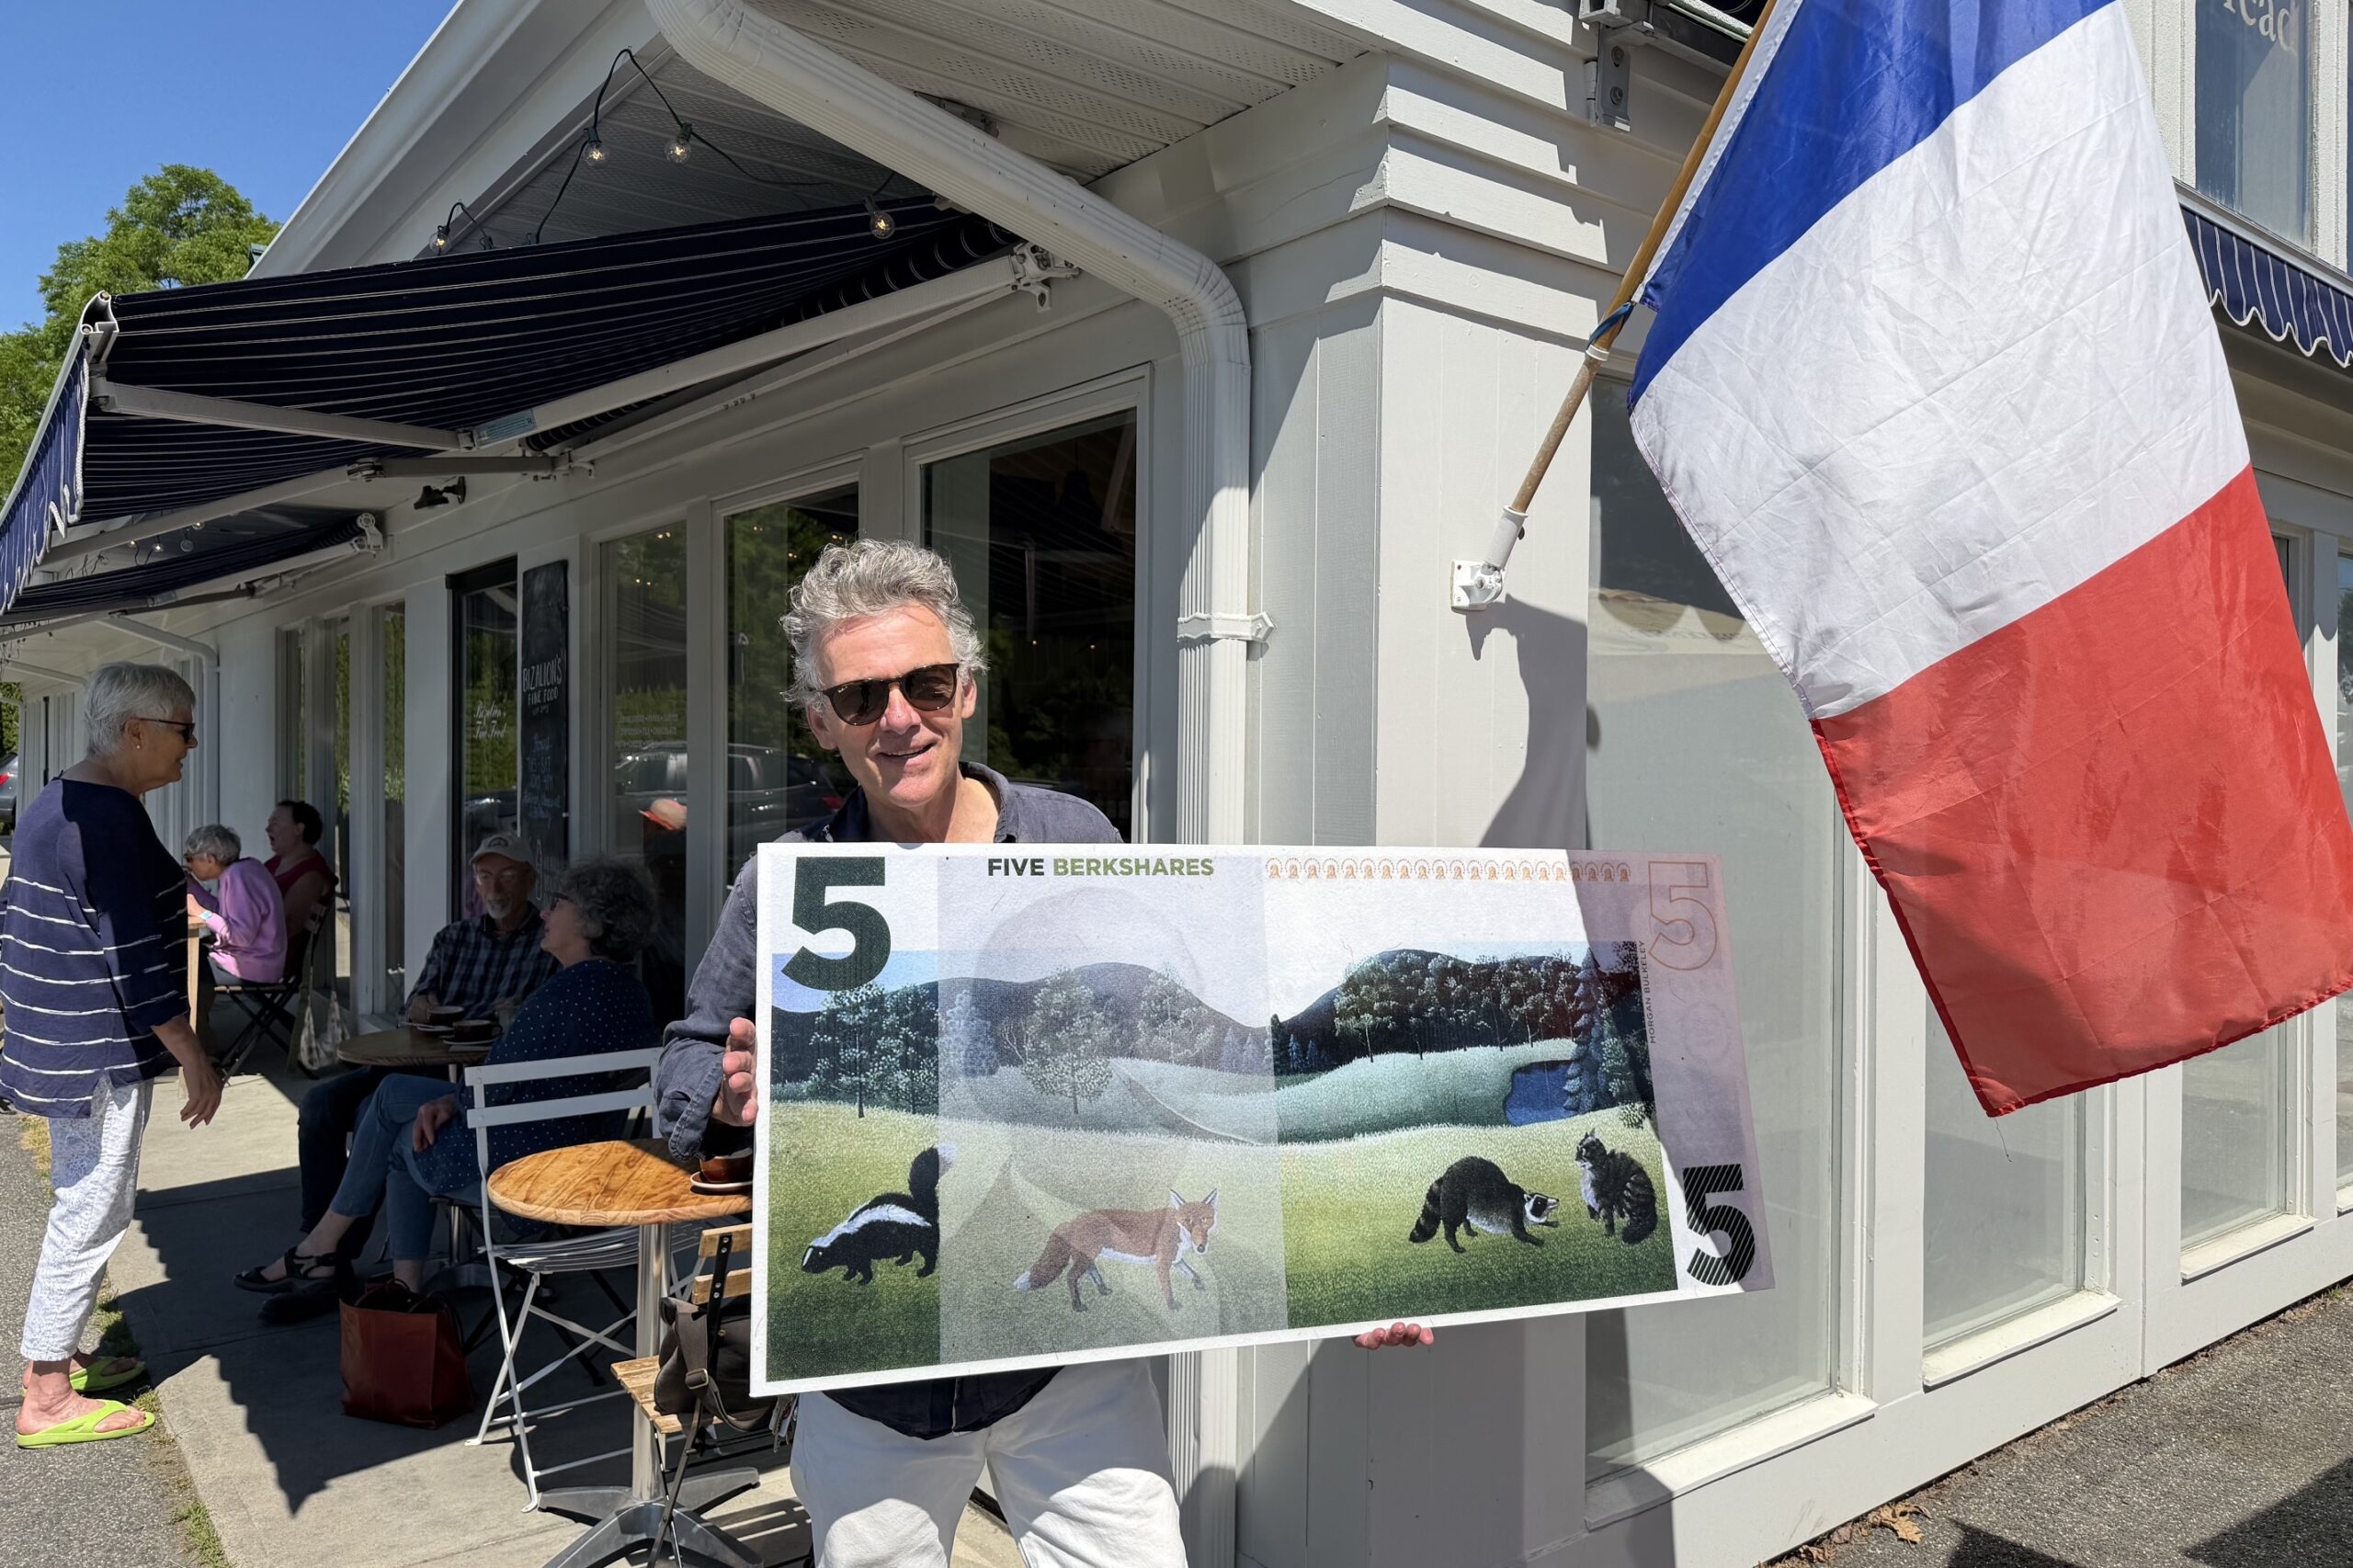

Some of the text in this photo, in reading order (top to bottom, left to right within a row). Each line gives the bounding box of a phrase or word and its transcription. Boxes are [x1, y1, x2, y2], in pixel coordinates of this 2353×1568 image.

[528, 686, 559, 707] FINE FOOD
[987, 858, 1215, 877] FIVE BERKSHARES
[1648, 860, 1717, 971] 5
[780, 856, 892, 992] 5
[1638, 940, 1657, 1044] MORGAN BULKELEY
[1683, 1163, 1756, 1287] 5
